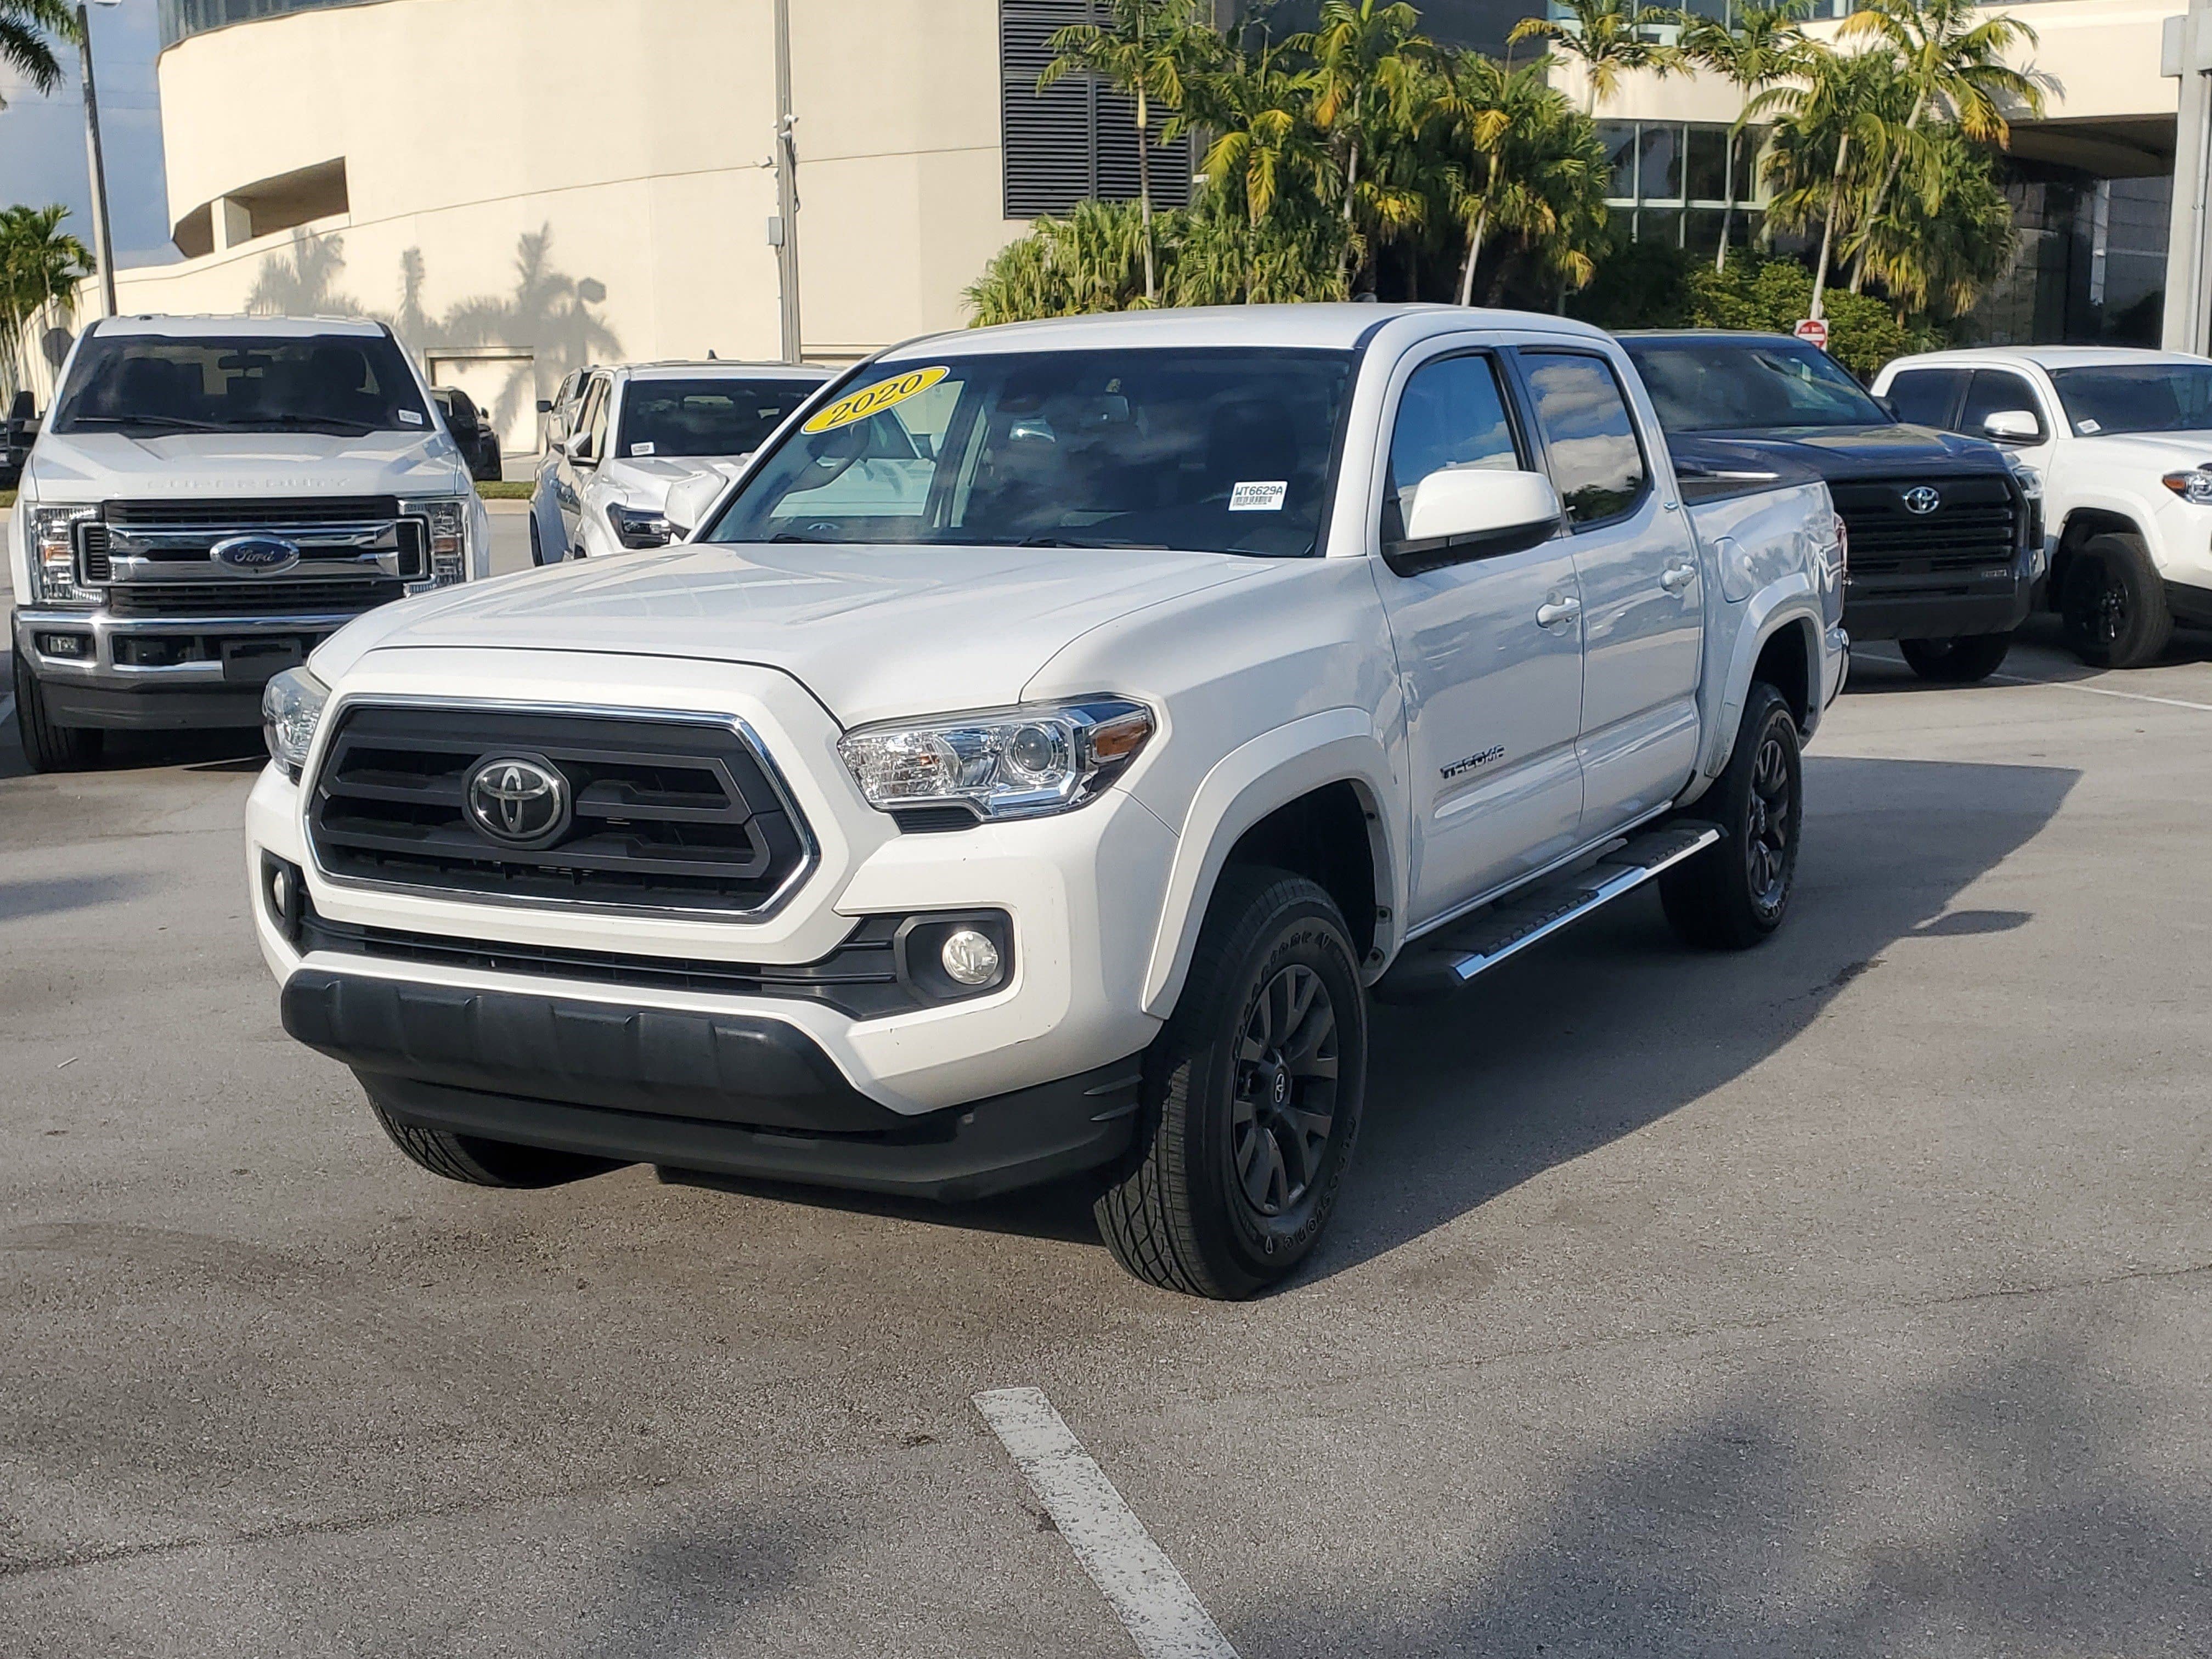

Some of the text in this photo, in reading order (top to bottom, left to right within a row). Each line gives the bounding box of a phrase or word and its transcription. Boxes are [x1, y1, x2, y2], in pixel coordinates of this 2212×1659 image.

[826, 374, 922, 426] 2020
[1235, 486, 1283, 495] WT6629A
[234, 546, 274, 563] Ford
